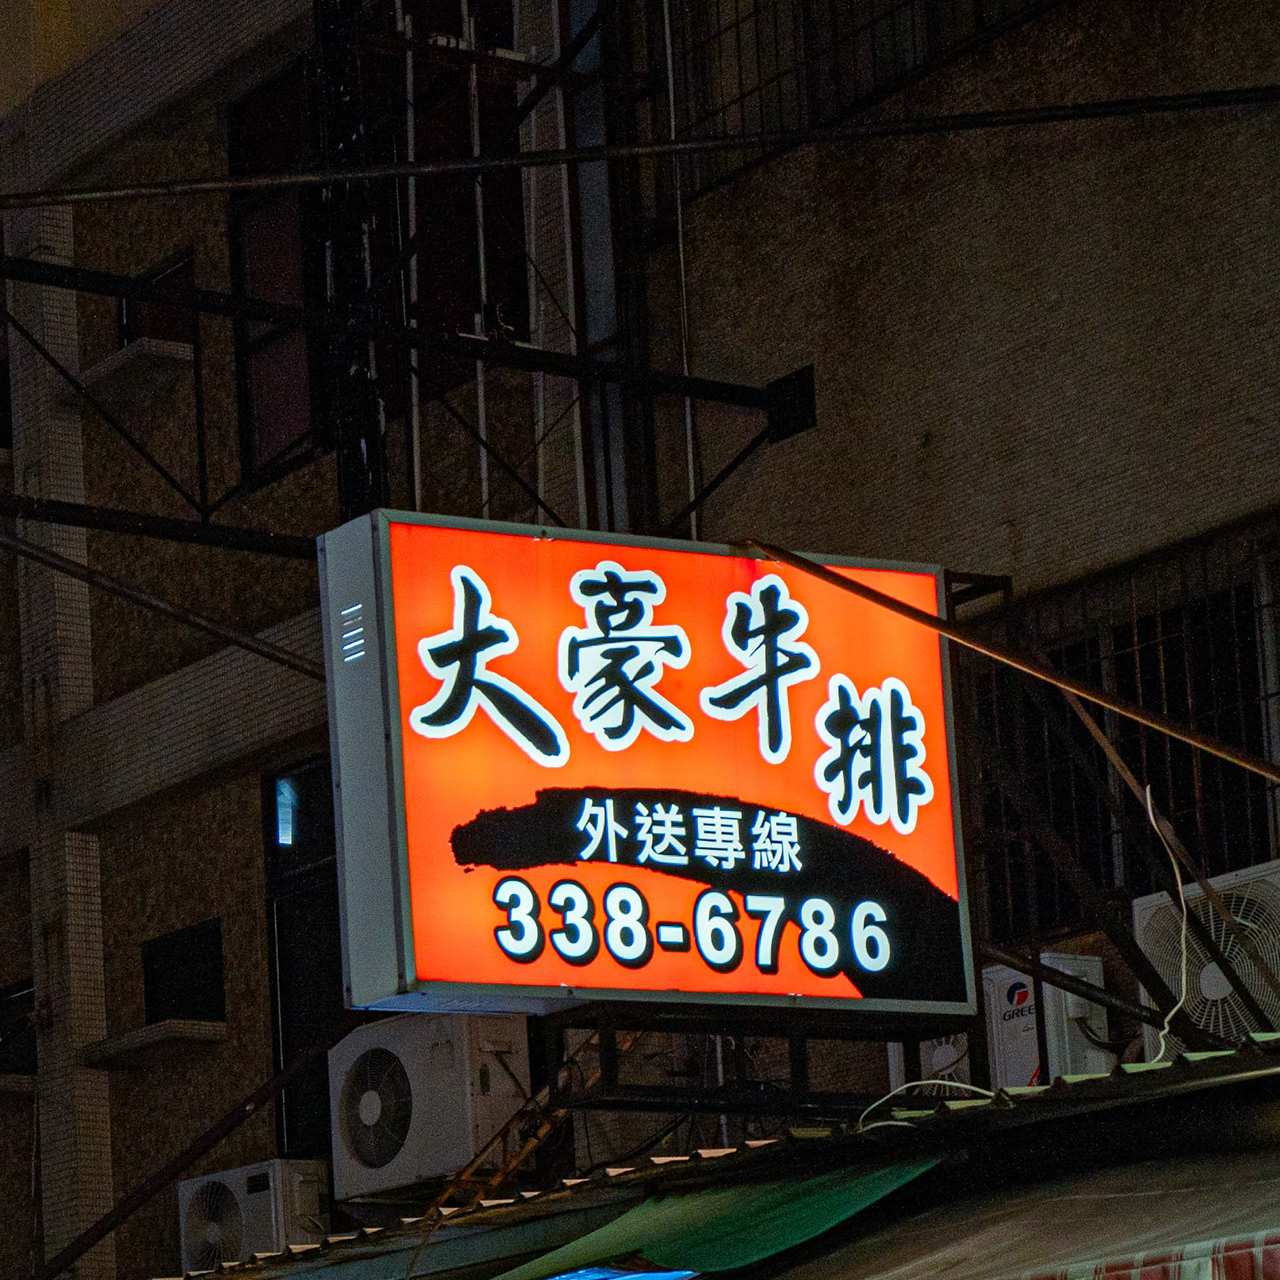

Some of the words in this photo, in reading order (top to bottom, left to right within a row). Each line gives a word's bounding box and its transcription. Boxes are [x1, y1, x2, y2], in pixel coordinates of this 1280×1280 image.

[412, 562, 932, 834] 大豪牛排
[576, 798, 803, 873] 外送專線
[495, 878, 892, 975] 338-6786
[1002, 1003, 1036, 1021] GREE
